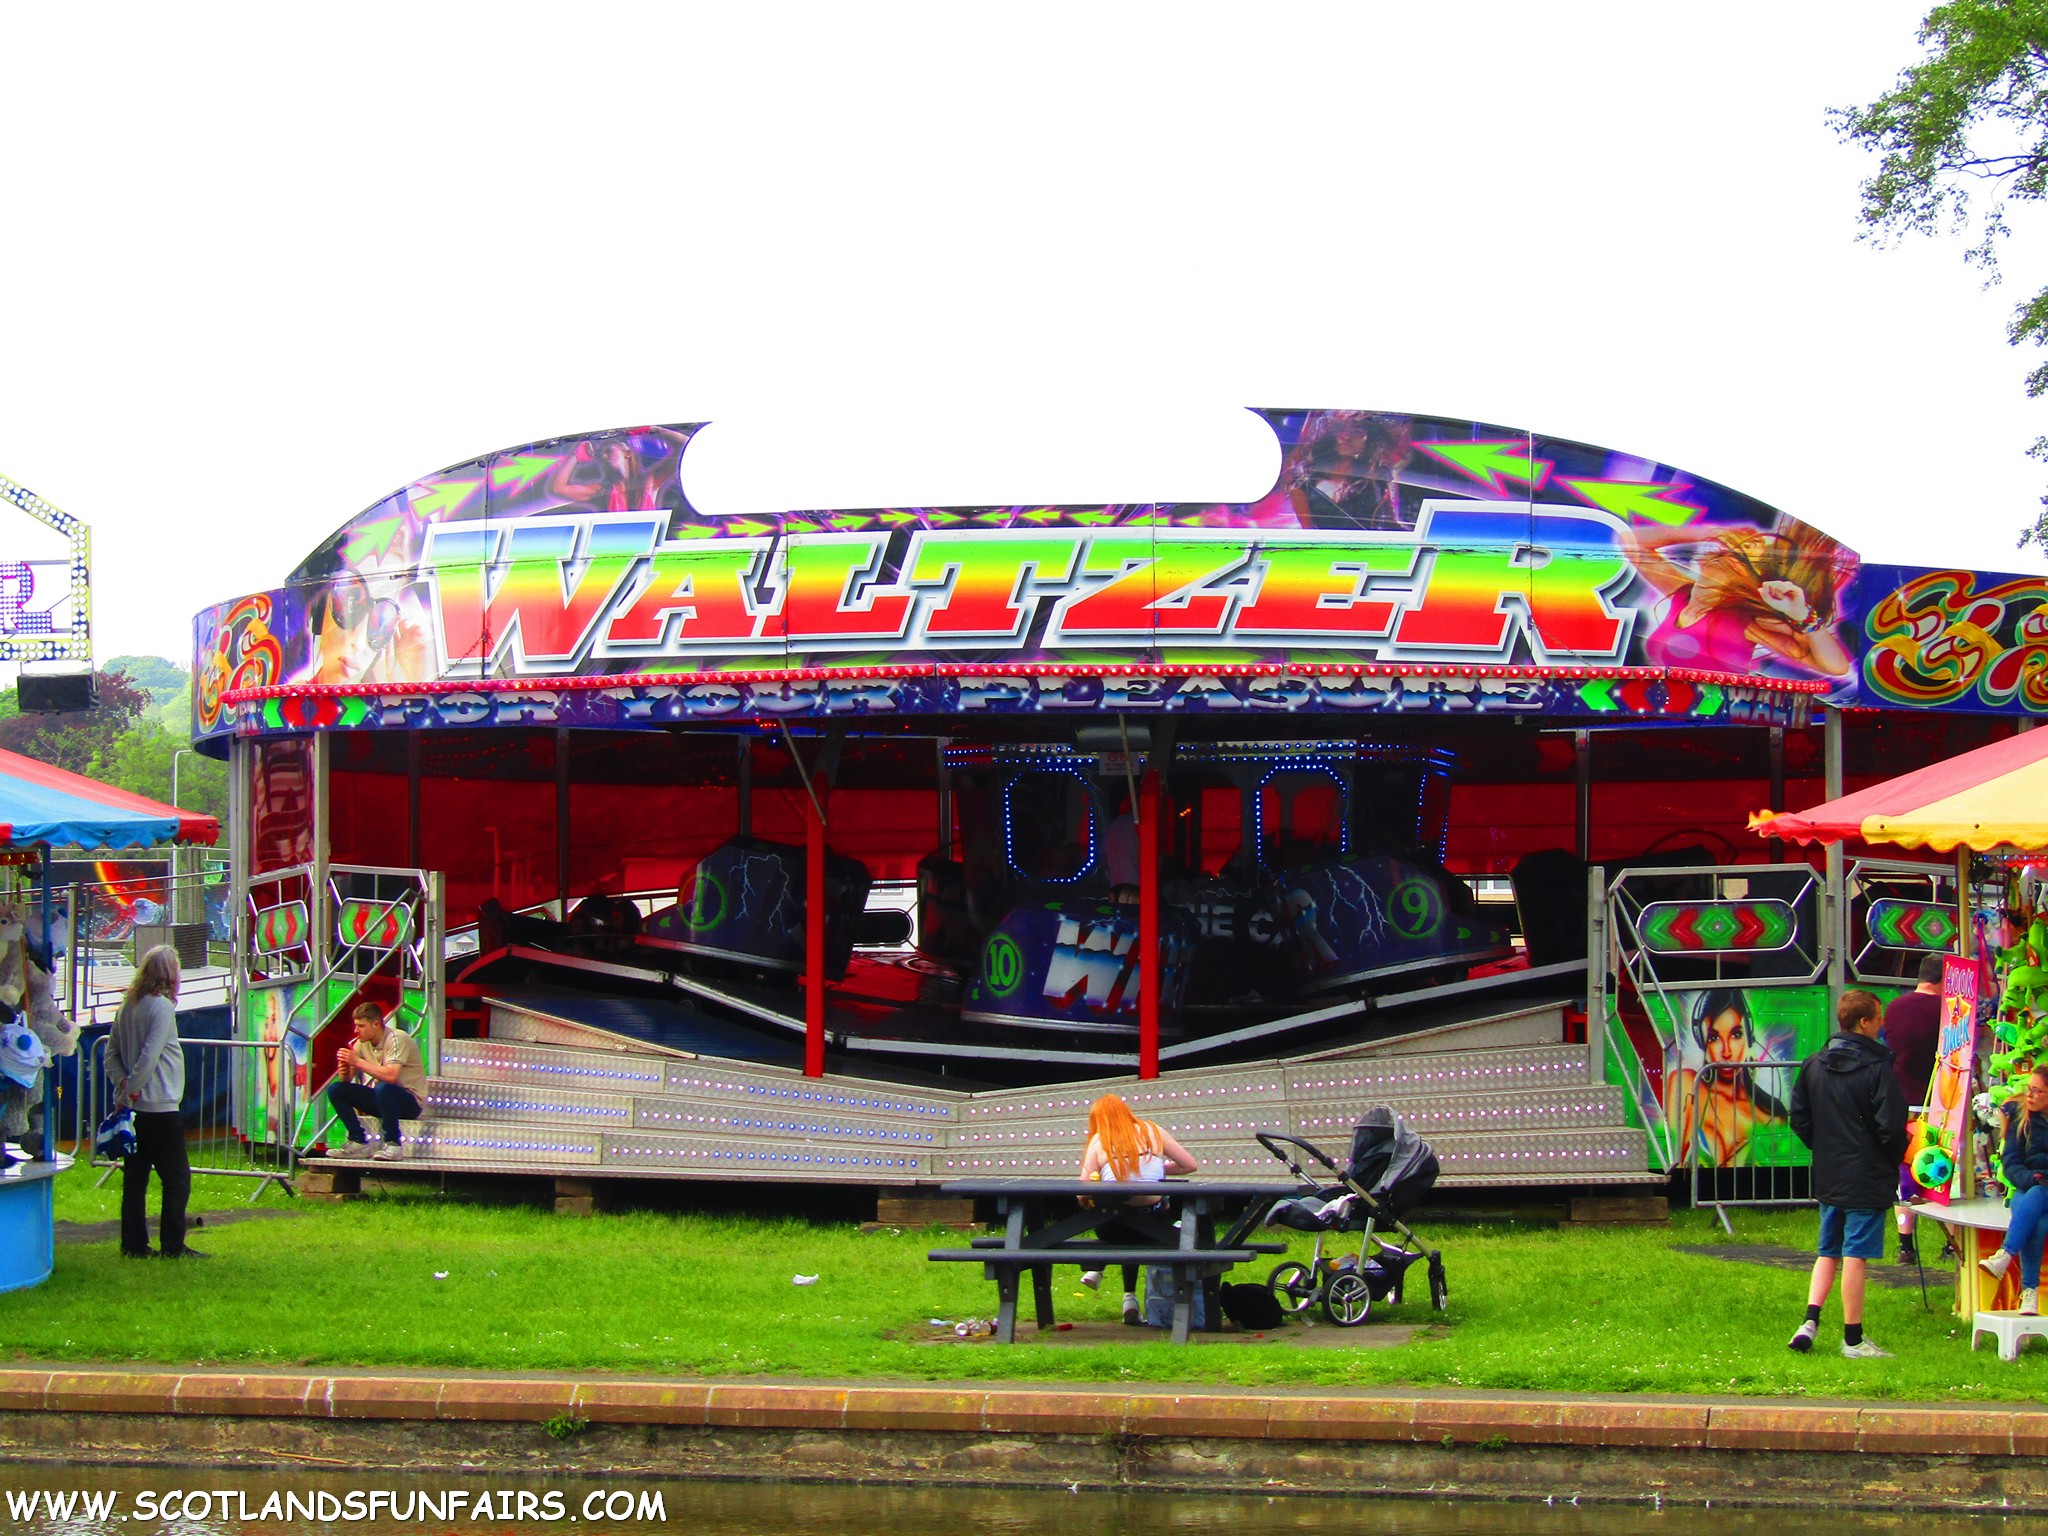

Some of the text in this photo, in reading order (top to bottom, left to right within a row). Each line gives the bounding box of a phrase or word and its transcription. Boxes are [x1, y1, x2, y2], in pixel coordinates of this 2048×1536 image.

[422, 500, 1639, 674] WALTZER
[380, 676, 1545, 726] FOR YOUR PLEASURE
[1945, 965, 1975, 999] HOOK
[1942, 1014, 1970, 1058] DUCK
